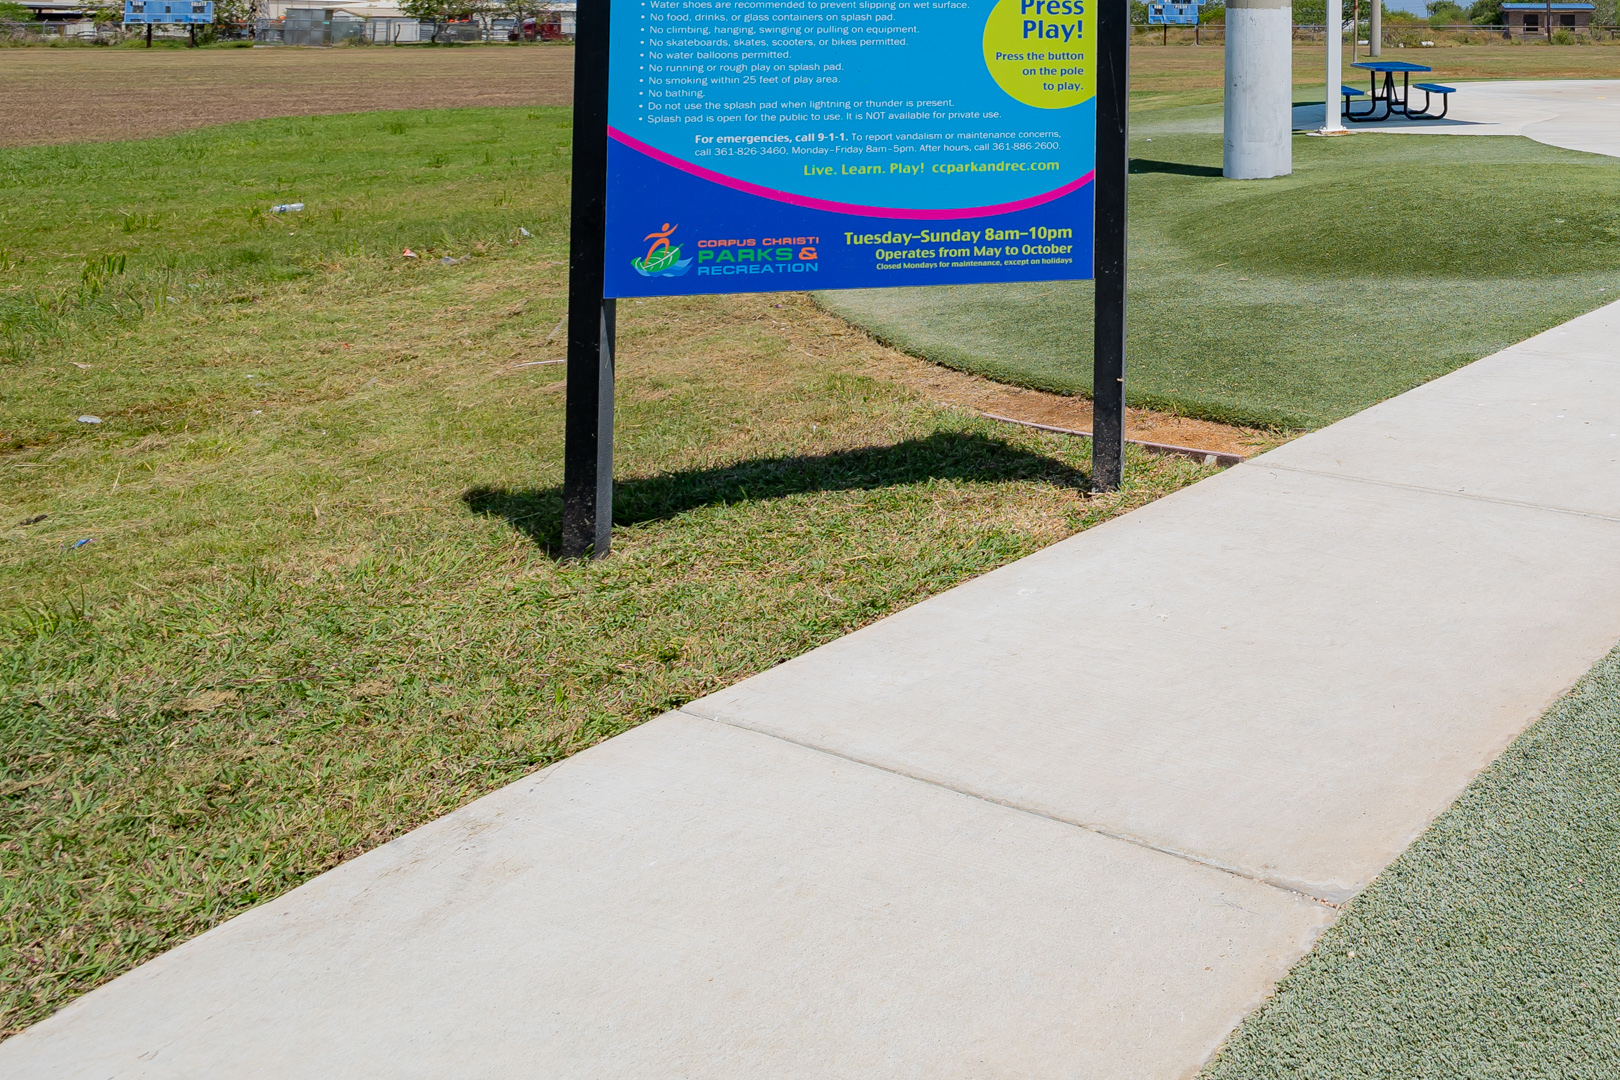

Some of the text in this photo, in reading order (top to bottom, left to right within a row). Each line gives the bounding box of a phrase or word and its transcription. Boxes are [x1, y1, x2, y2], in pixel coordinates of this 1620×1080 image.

[649, 0, 680, 9] Water
[682, 0, 713, 9] shoes
[714, 1, 732, 9] are
[734, 0, 805, 9] recommended
[807, 1, 818, 9] to
[819, 1, 857, 10] prevent
[858, 0, 897, 11] slipping
[913, 1, 930, 9] wet
[931, 0, 970, 9] surface.
[650, 12, 895, 23] No food, drinks, or glass containers on splash pad.
[649, 25, 664, 34] No
[666, 25, 711, 36] climbing,
[714, 25, 757, 36] hanging,
[758, 26, 802, 36] swinging
[816, 25, 850, 36] pulling
[851, 26, 864, 34] on
[865, 25, 920, 35] equipment.
[1023, 19, 1083, 43] Play!
[649, 37, 908, 47] No skateboards, skates, scooters, or bikes permitted.
[648, 50, 791, 61] No water balloons permitted.
[995, 51, 1084, 61] Press the button
[1022, 66, 1084, 77] on the pole
[648, 75, 840, 87] No smoking within 25 feet of play area.
[1042, 81, 1084, 92] to play.
[648, 89, 706, 100] No bathing.
[694, 134, 715, 145] For
[715, 133, 793, 145] emergencies,
[794, 132, 816, 143] call
[817, 132, 849, 142] 9-1-1.
[851, 132, 863, 142] To
[865, 133, 893, 142] report
[895, 132, 943, 141] vandalism
[956, 131, 1016, 140] maintenance
[1018, 131, 1062, 139] concerns,
[694, 148, 712, 157] call
[714, 146, 789, 157] 361-826-3460.
[919, 143, 941, 152] After
[943, 143, 972, 152] hours,
[973, 143, 990, 152] call
[992, 141, 1061, 151] 361-886-2600.
[803, 160, 1060, 176] Live. Learn. Play! ccparkandrec.com
[697, 236, 820, 249] CORPUS CHRISTI
[698, 246, 819, 264] PARKS &
[875, 243, 1073, 262] Operates from May to October
[697, 262, 818, 276] RECREATION
[876, 262, 902, 270] Closed
[902, 261, 938, 269] Mondays
[951, 260, 1003, 268] maintenance,
[1003, 258, 1030, 266] except
[1041, 257, 1073, 265] holidays
